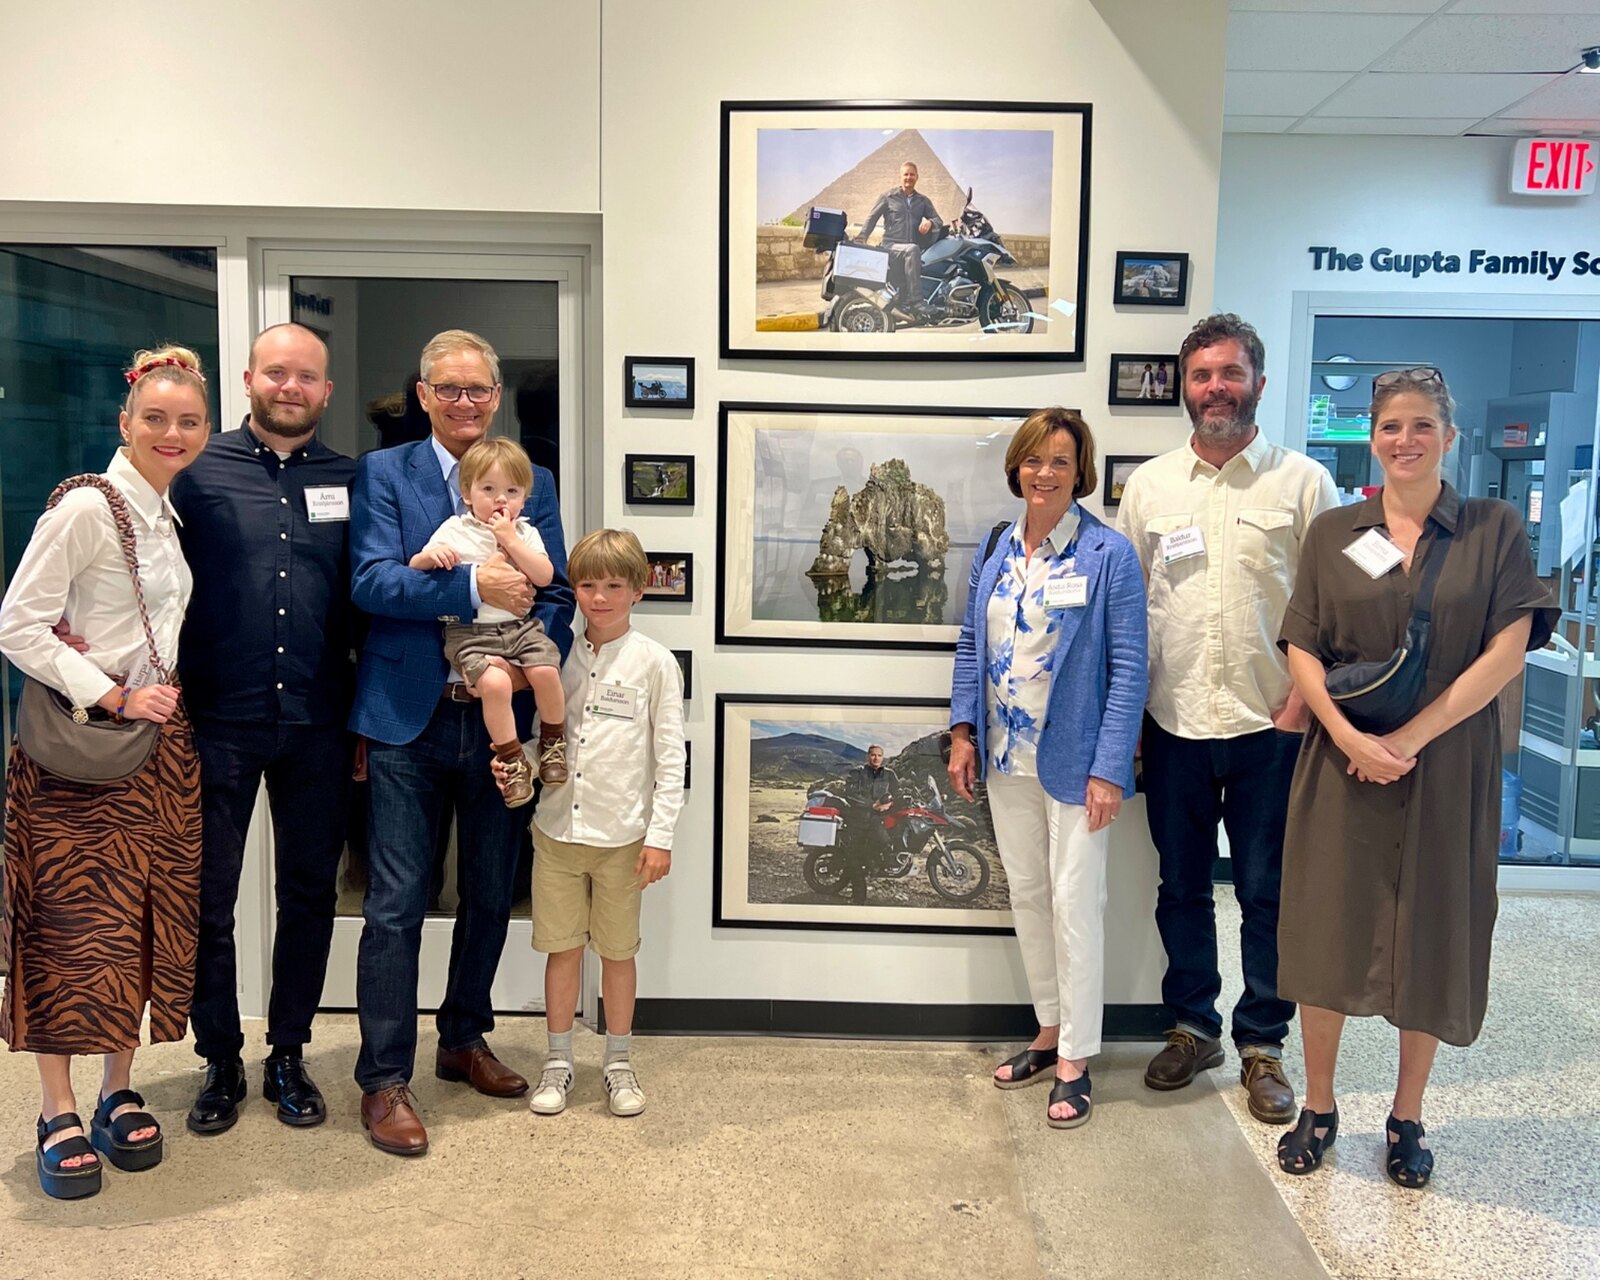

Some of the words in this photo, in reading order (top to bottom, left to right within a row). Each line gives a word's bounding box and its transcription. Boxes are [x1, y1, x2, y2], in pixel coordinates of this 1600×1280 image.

[1526, 141, 1590, 190] EXIT
[1308, 246, 1364, 272] The
[1370, 248, 1461, 278] Gupta
[1469, 249, 1567, 281] Family
